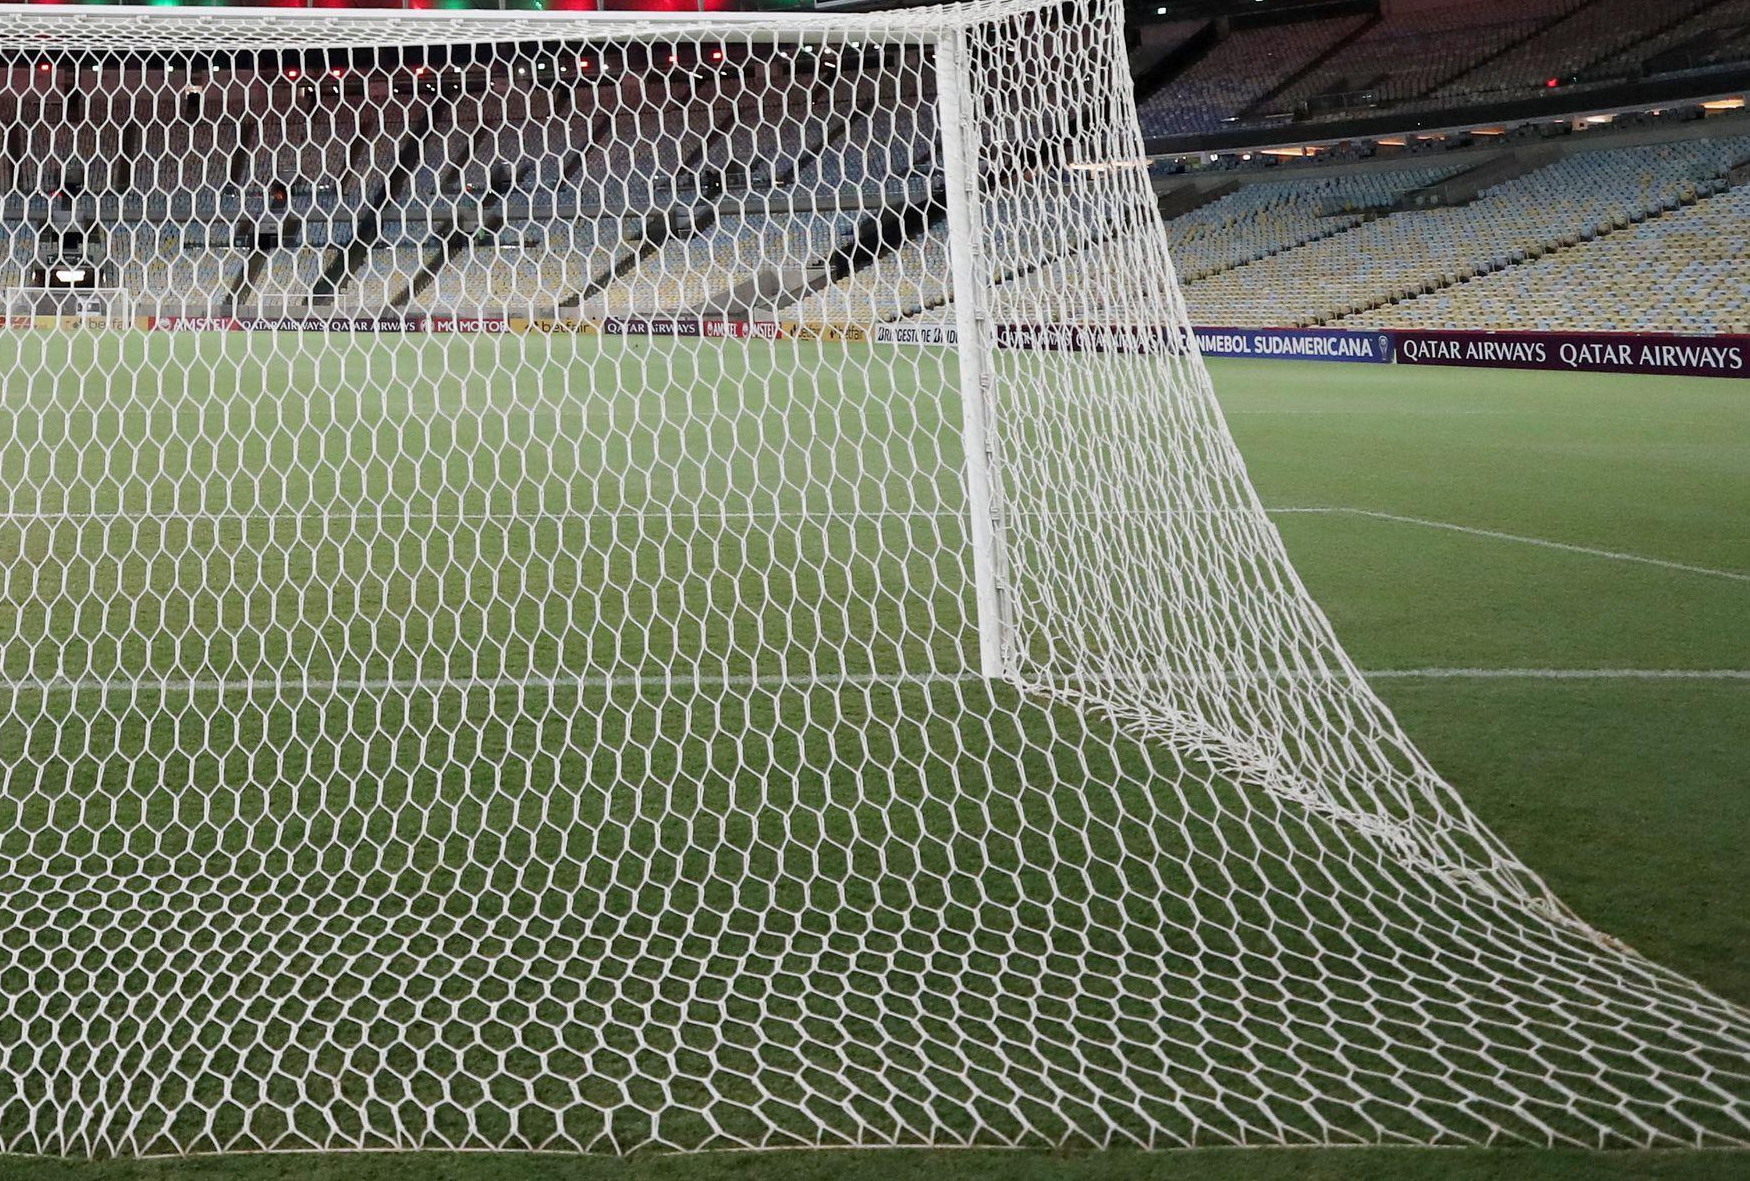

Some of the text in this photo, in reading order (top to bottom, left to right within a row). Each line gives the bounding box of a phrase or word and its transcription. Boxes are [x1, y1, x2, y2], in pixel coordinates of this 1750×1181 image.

[89, 317, 132, 330] befa
[332, 321, 416, 332] QAAR ARWYS
[459, 321, 509, 332] MOTOR
[713, 322, 738, 337] AMTEL
[750, 323, 776, 339] MSTEL
[878, 327, 932, 343] BRIGESTNE
[1254, 336, 1374, 357] SUDAMERICANA
[1403, 339, 1546, 363] QATAR AIRWAYS
[1559, 343, 1743, 369] QATAR AIRWAYS
